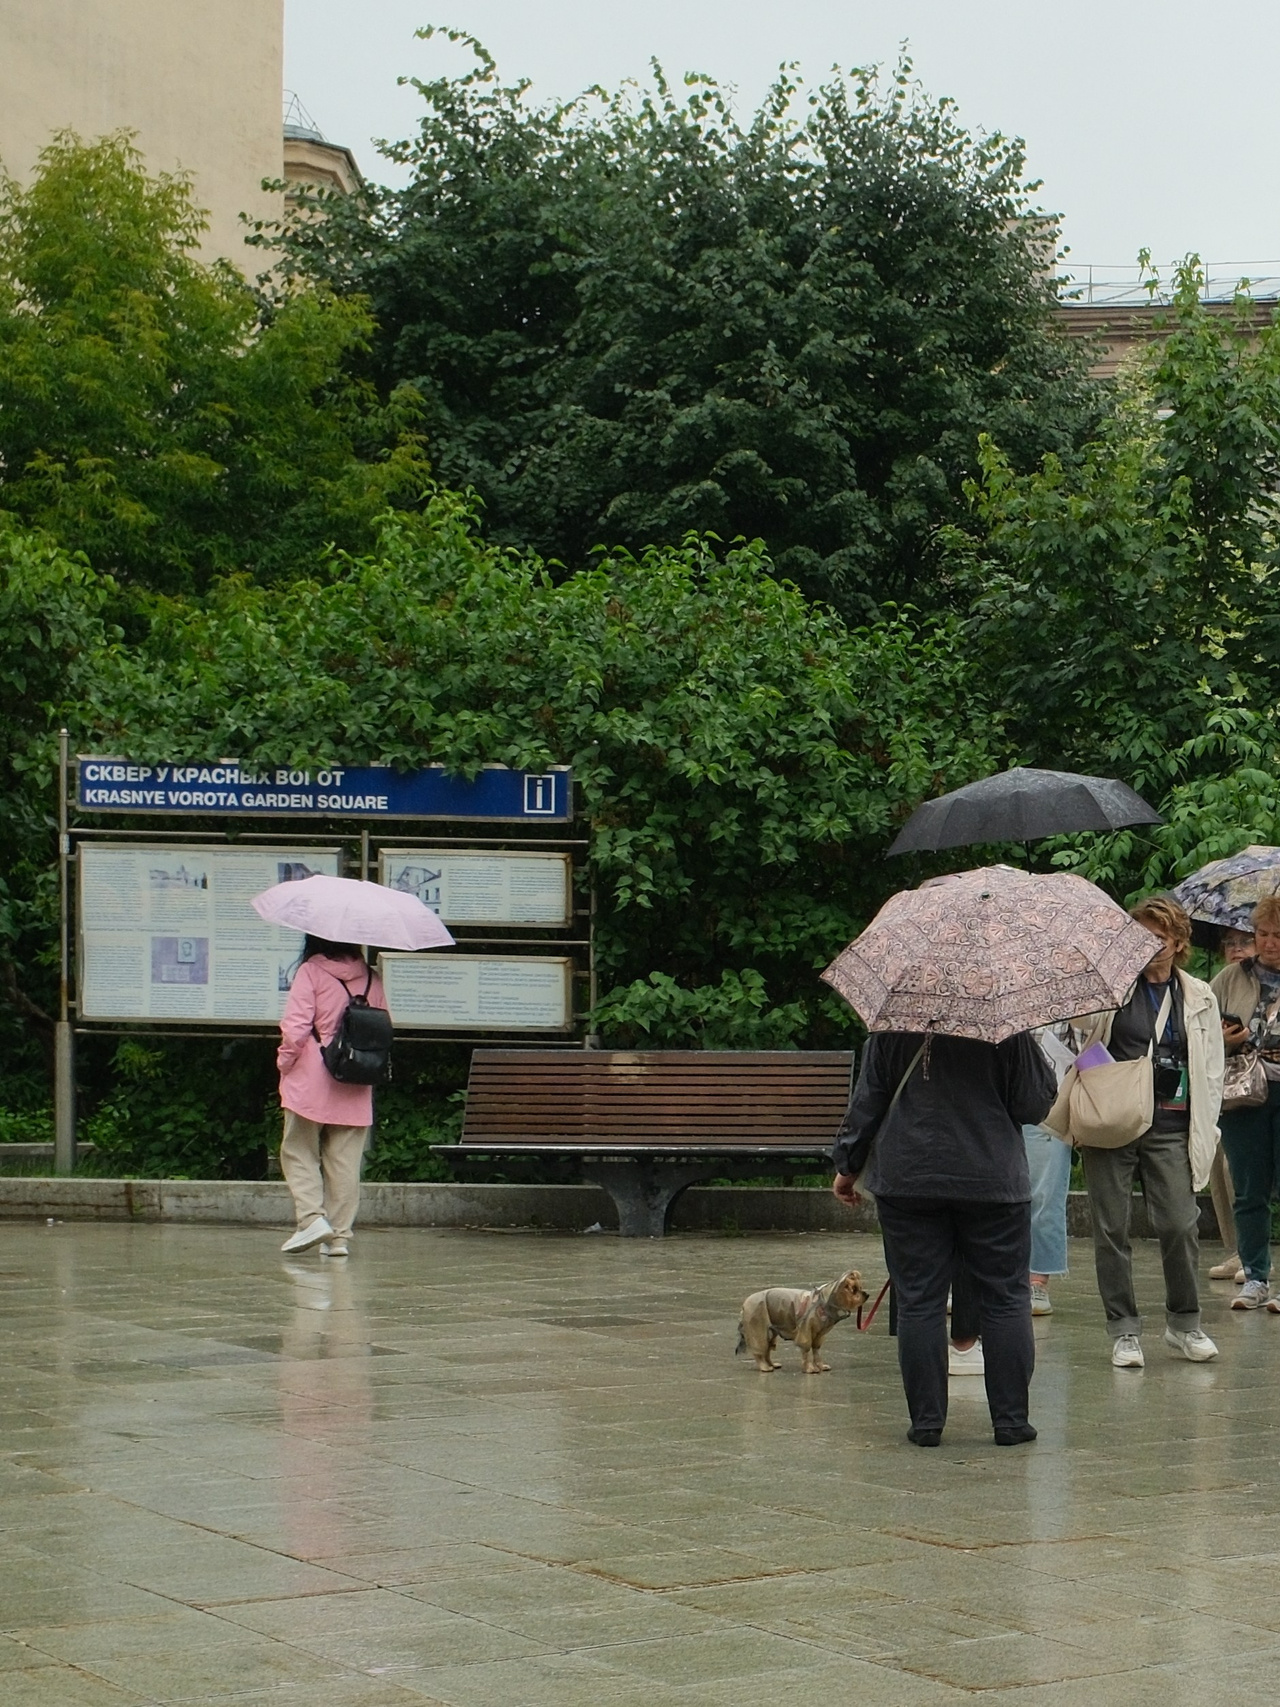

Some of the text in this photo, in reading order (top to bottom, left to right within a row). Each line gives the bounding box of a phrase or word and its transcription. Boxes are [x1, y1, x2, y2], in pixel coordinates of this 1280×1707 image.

[85, 764, 152, 782] СКВЕР
[156, 766, 169, 783] У
[85, 789, 388, 810] KRASNYE VOROTA GARDEN SQUARE
